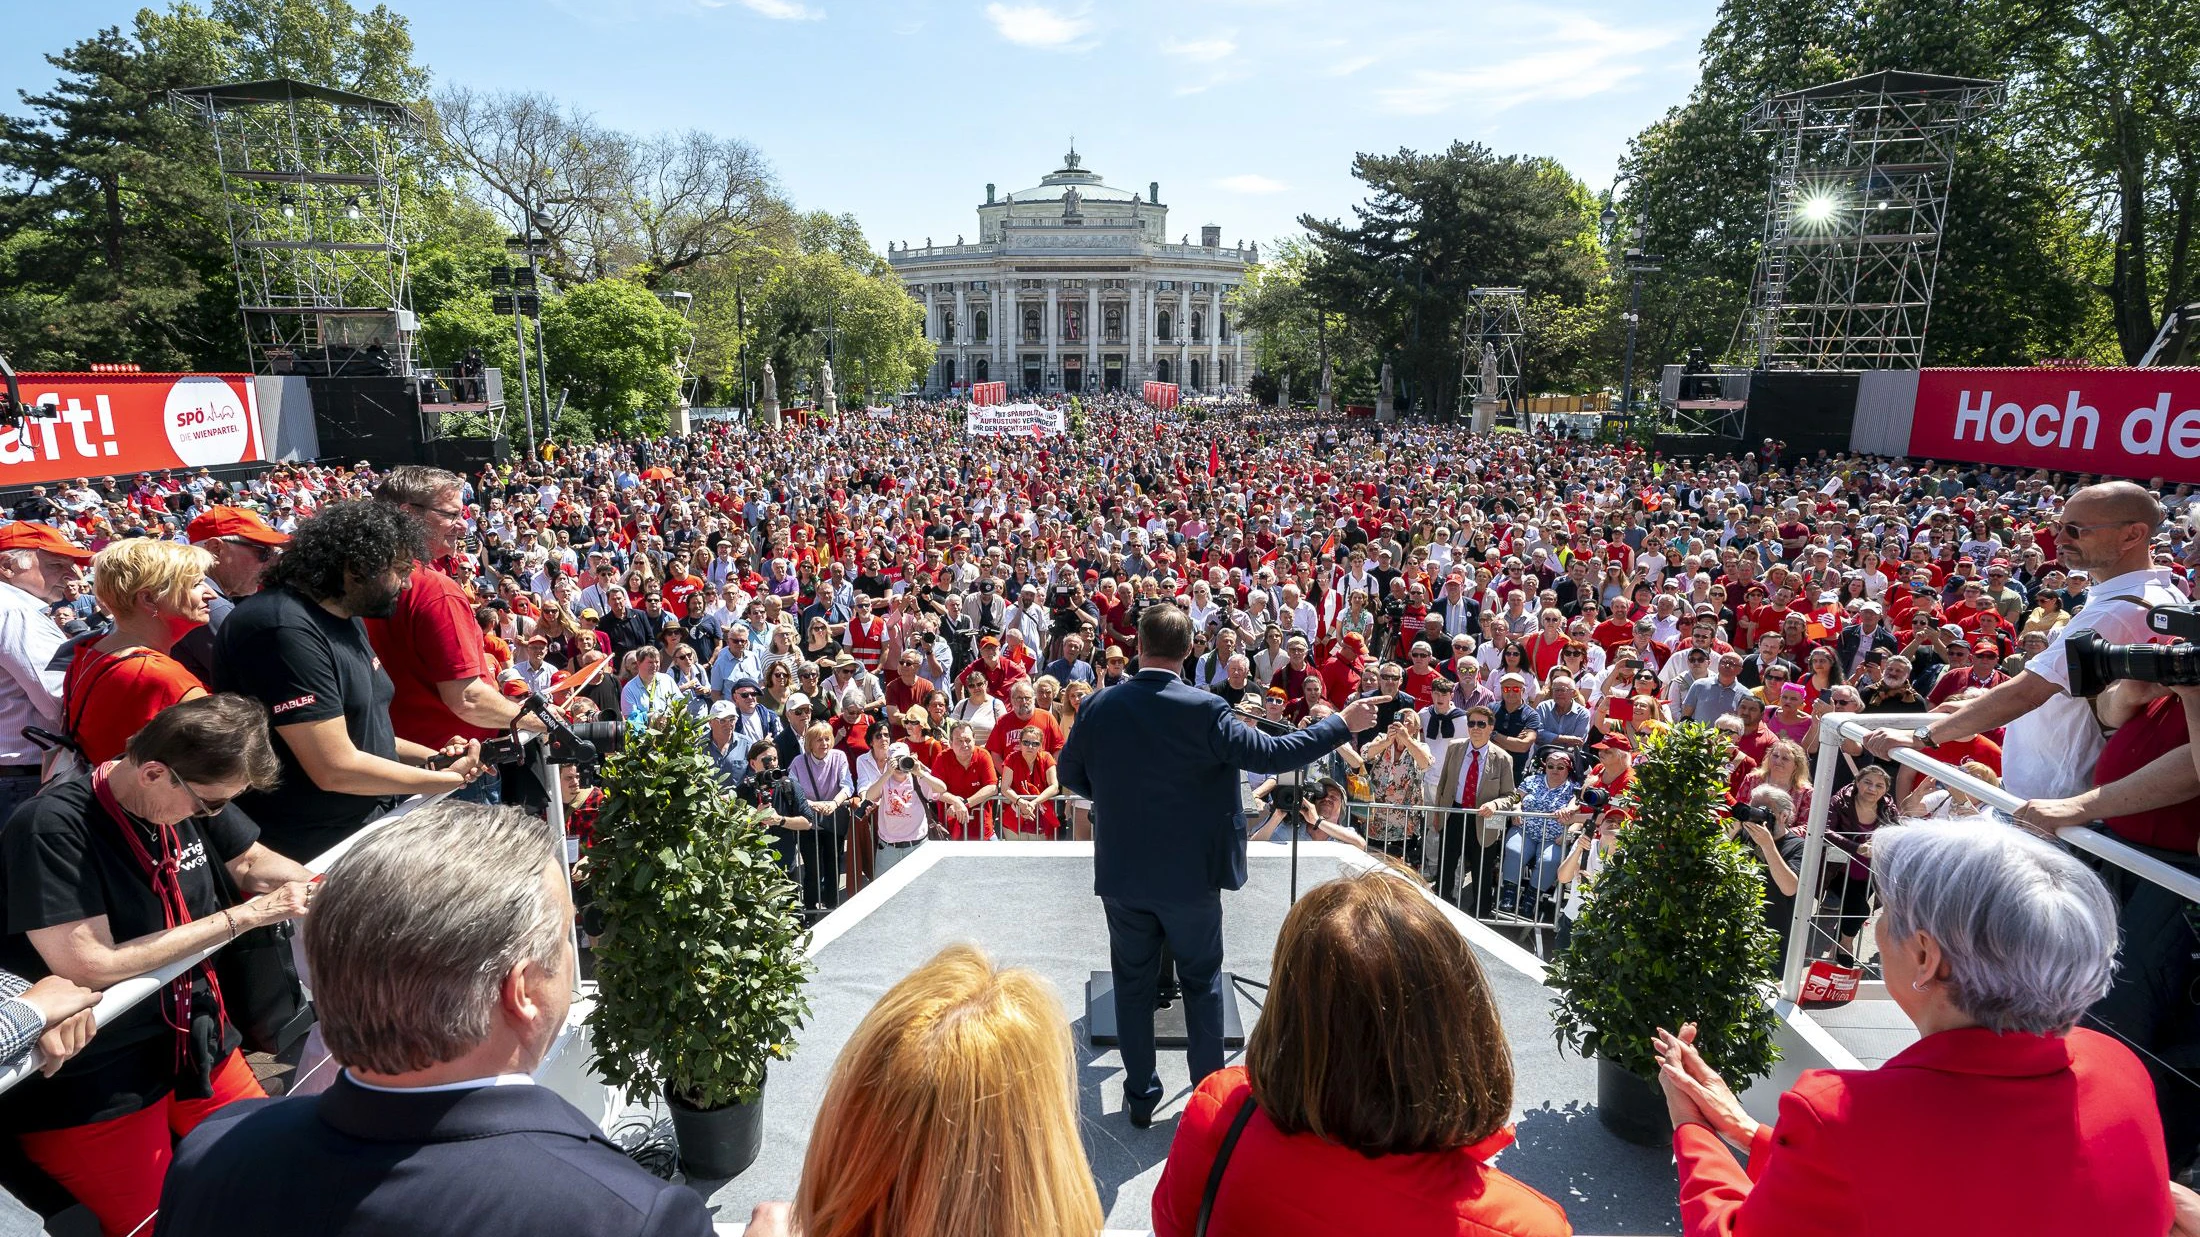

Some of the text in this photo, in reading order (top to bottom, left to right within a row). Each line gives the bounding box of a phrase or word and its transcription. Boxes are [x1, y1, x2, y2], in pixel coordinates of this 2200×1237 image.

[177, 407, 205, 427] SPÖ
[1953, 390, 2200, 459] Hoch de
[180, 432, 192, 443] DIE
[274, 694, 315, 714] BABLER
[540, 710, 559, 730] RONIN
